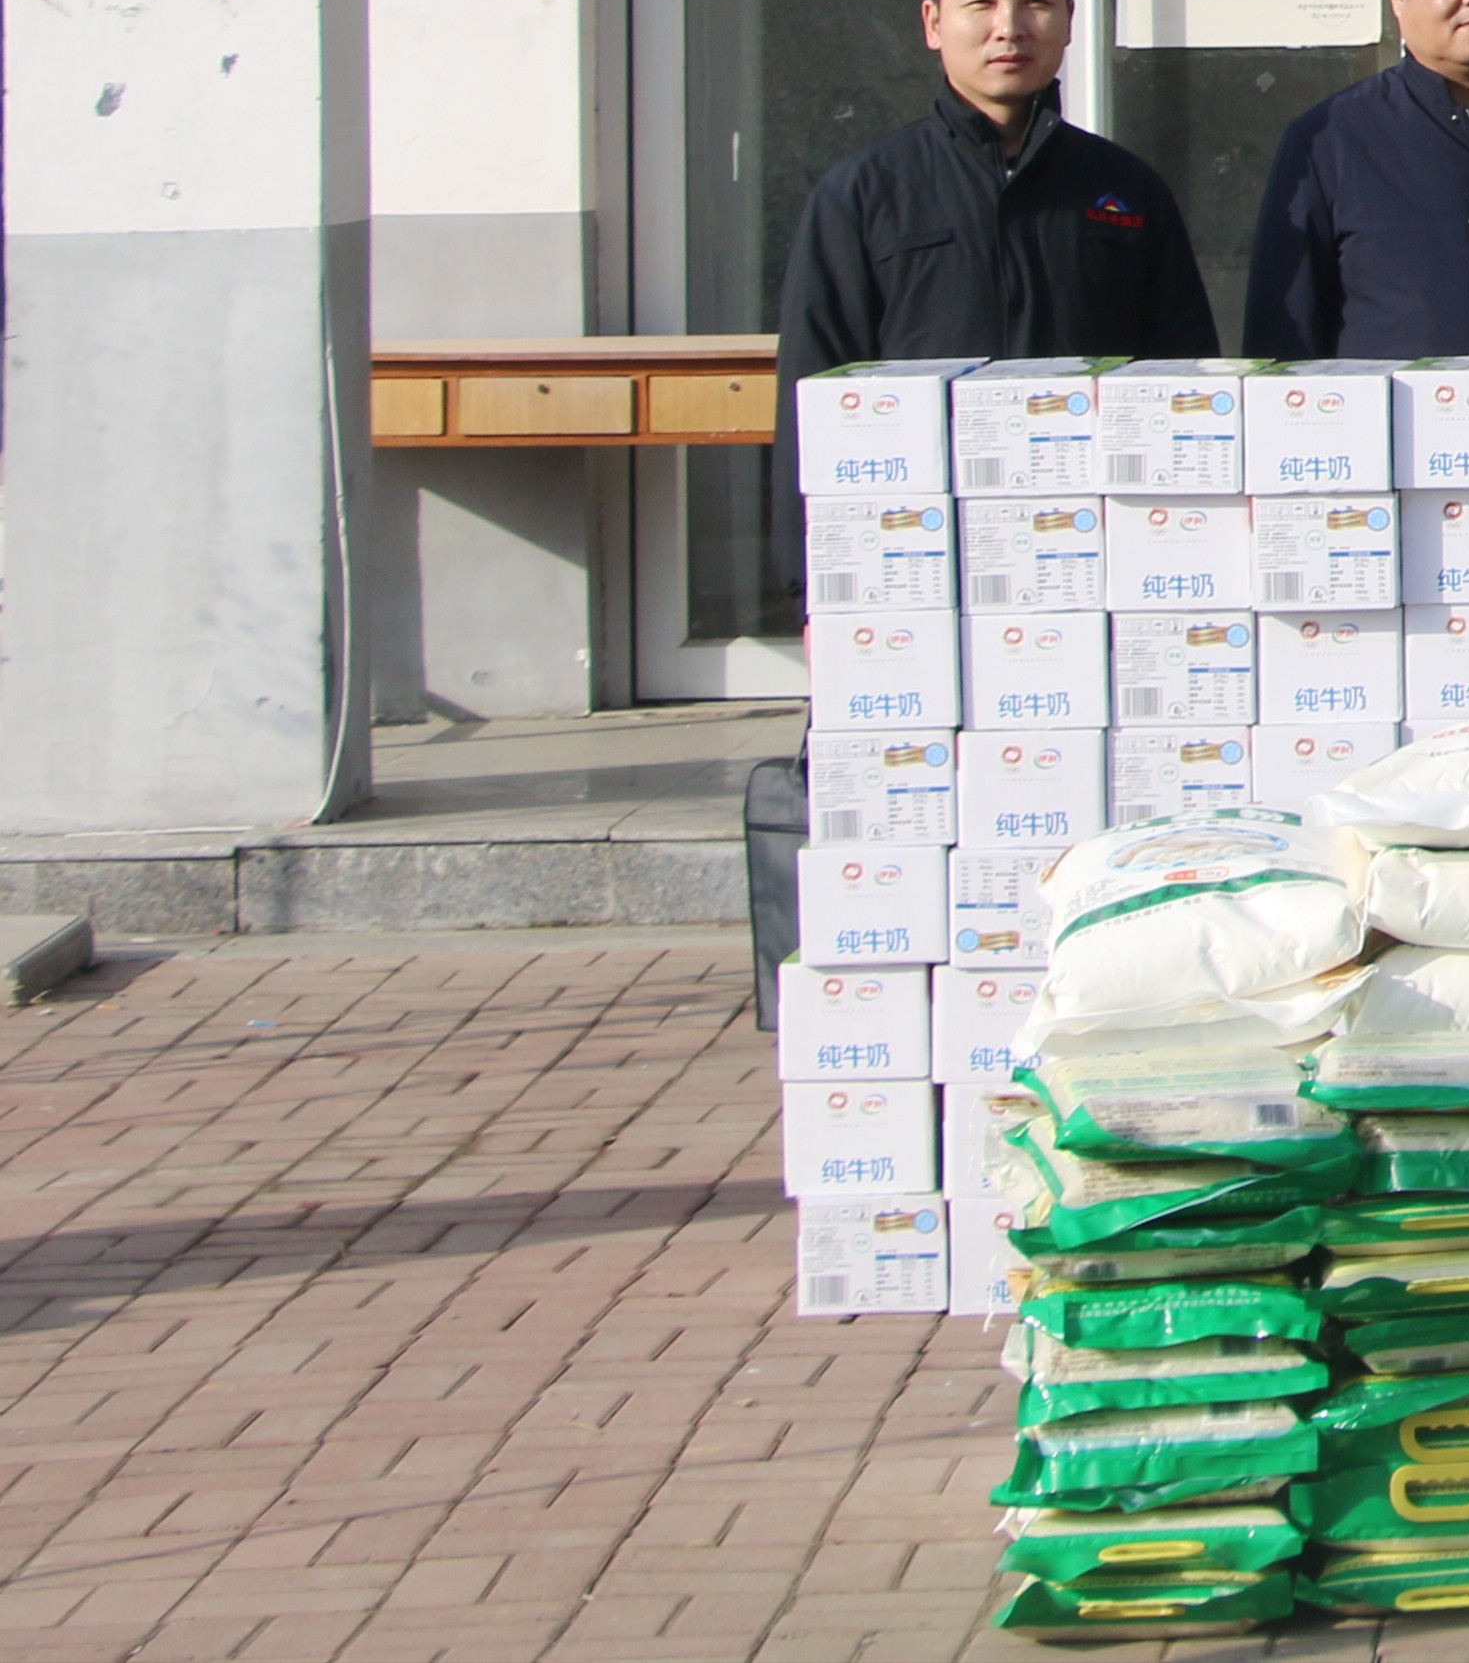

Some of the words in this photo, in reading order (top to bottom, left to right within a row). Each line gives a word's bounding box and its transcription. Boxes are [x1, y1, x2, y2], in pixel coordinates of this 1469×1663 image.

[836, 457, 908, 482] 纯牛奶
[1280, 456, 1352, 480] 纯牛奶
[1142, 574, 1214, 597] 纯牛奶
[849, 692, 922, 717] 纯牛奶
[998, 692, 1071, 717] 纯牛奶
[1295, 686, 1366, 710] 纯牛奶
[996, 811, 1068, 837] 纯牛奶
[837, 928, 910, 952] 纯牛奶
[817, 1043, 890, 1068] 纯牛奶
[823, 1157, 893, 1182] 纯牛奶
